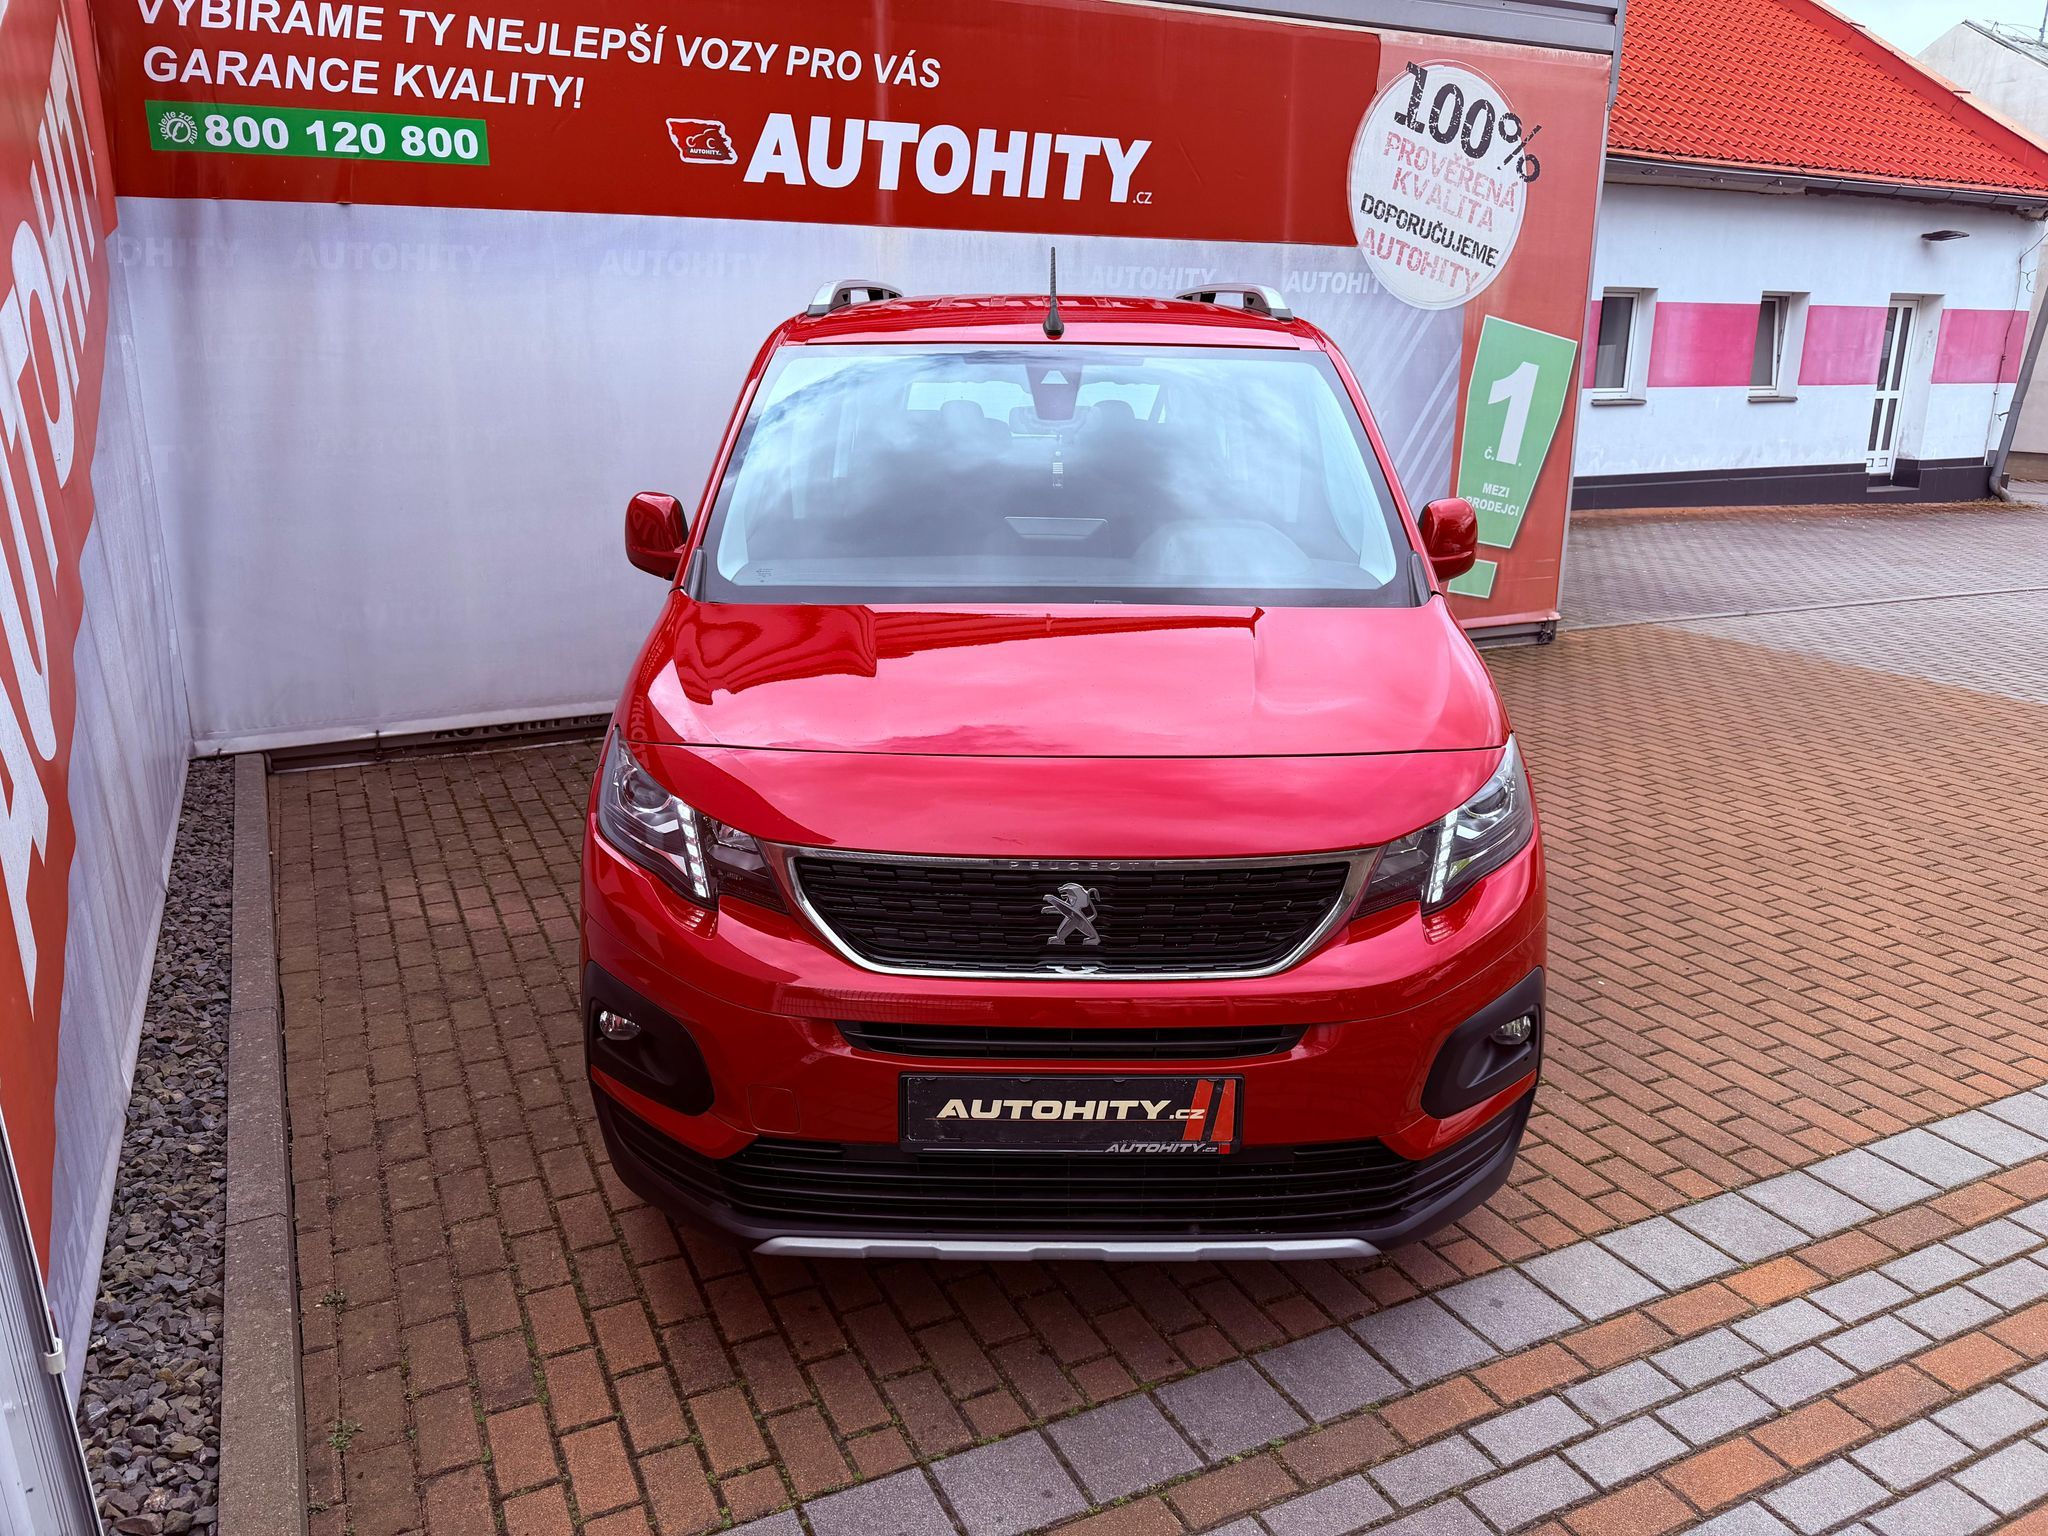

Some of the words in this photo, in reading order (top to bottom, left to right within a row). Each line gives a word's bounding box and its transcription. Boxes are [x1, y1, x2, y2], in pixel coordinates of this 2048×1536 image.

[143, 45, 380, 95] GARANCE
[393, 63, 585, 109] KVALITY!
[399, 10, 456, 46] TY
[465, 16, 667, 65] NEJLEPŠÍ
[674, 34, 778, 74] VOZY
[785, 45, 863, 82] PRO
[874, 49, 941, 90] VÁS
[158, 111, 177, 140] volejte
[178, 111, 198, 145] zdarma
[203, 114, 290, 151] 800
[305, 120, 386, 155] 120
[401, 125, 479, 159] 800
[1394, 61, 1543, 183] 100%
[1383, 131, 1519, 213] PROVĚŘENÁ
[1392, 167, 1494, 233] KVALITA
[1360, 192, 1500, 269] DOPORUČUJEME
[1361, 227, 1481, 295] AUTOHITY
[1284, 270, 1388, 294] AUTOHIT
[1482, 482, 1510, 498] MEZI
